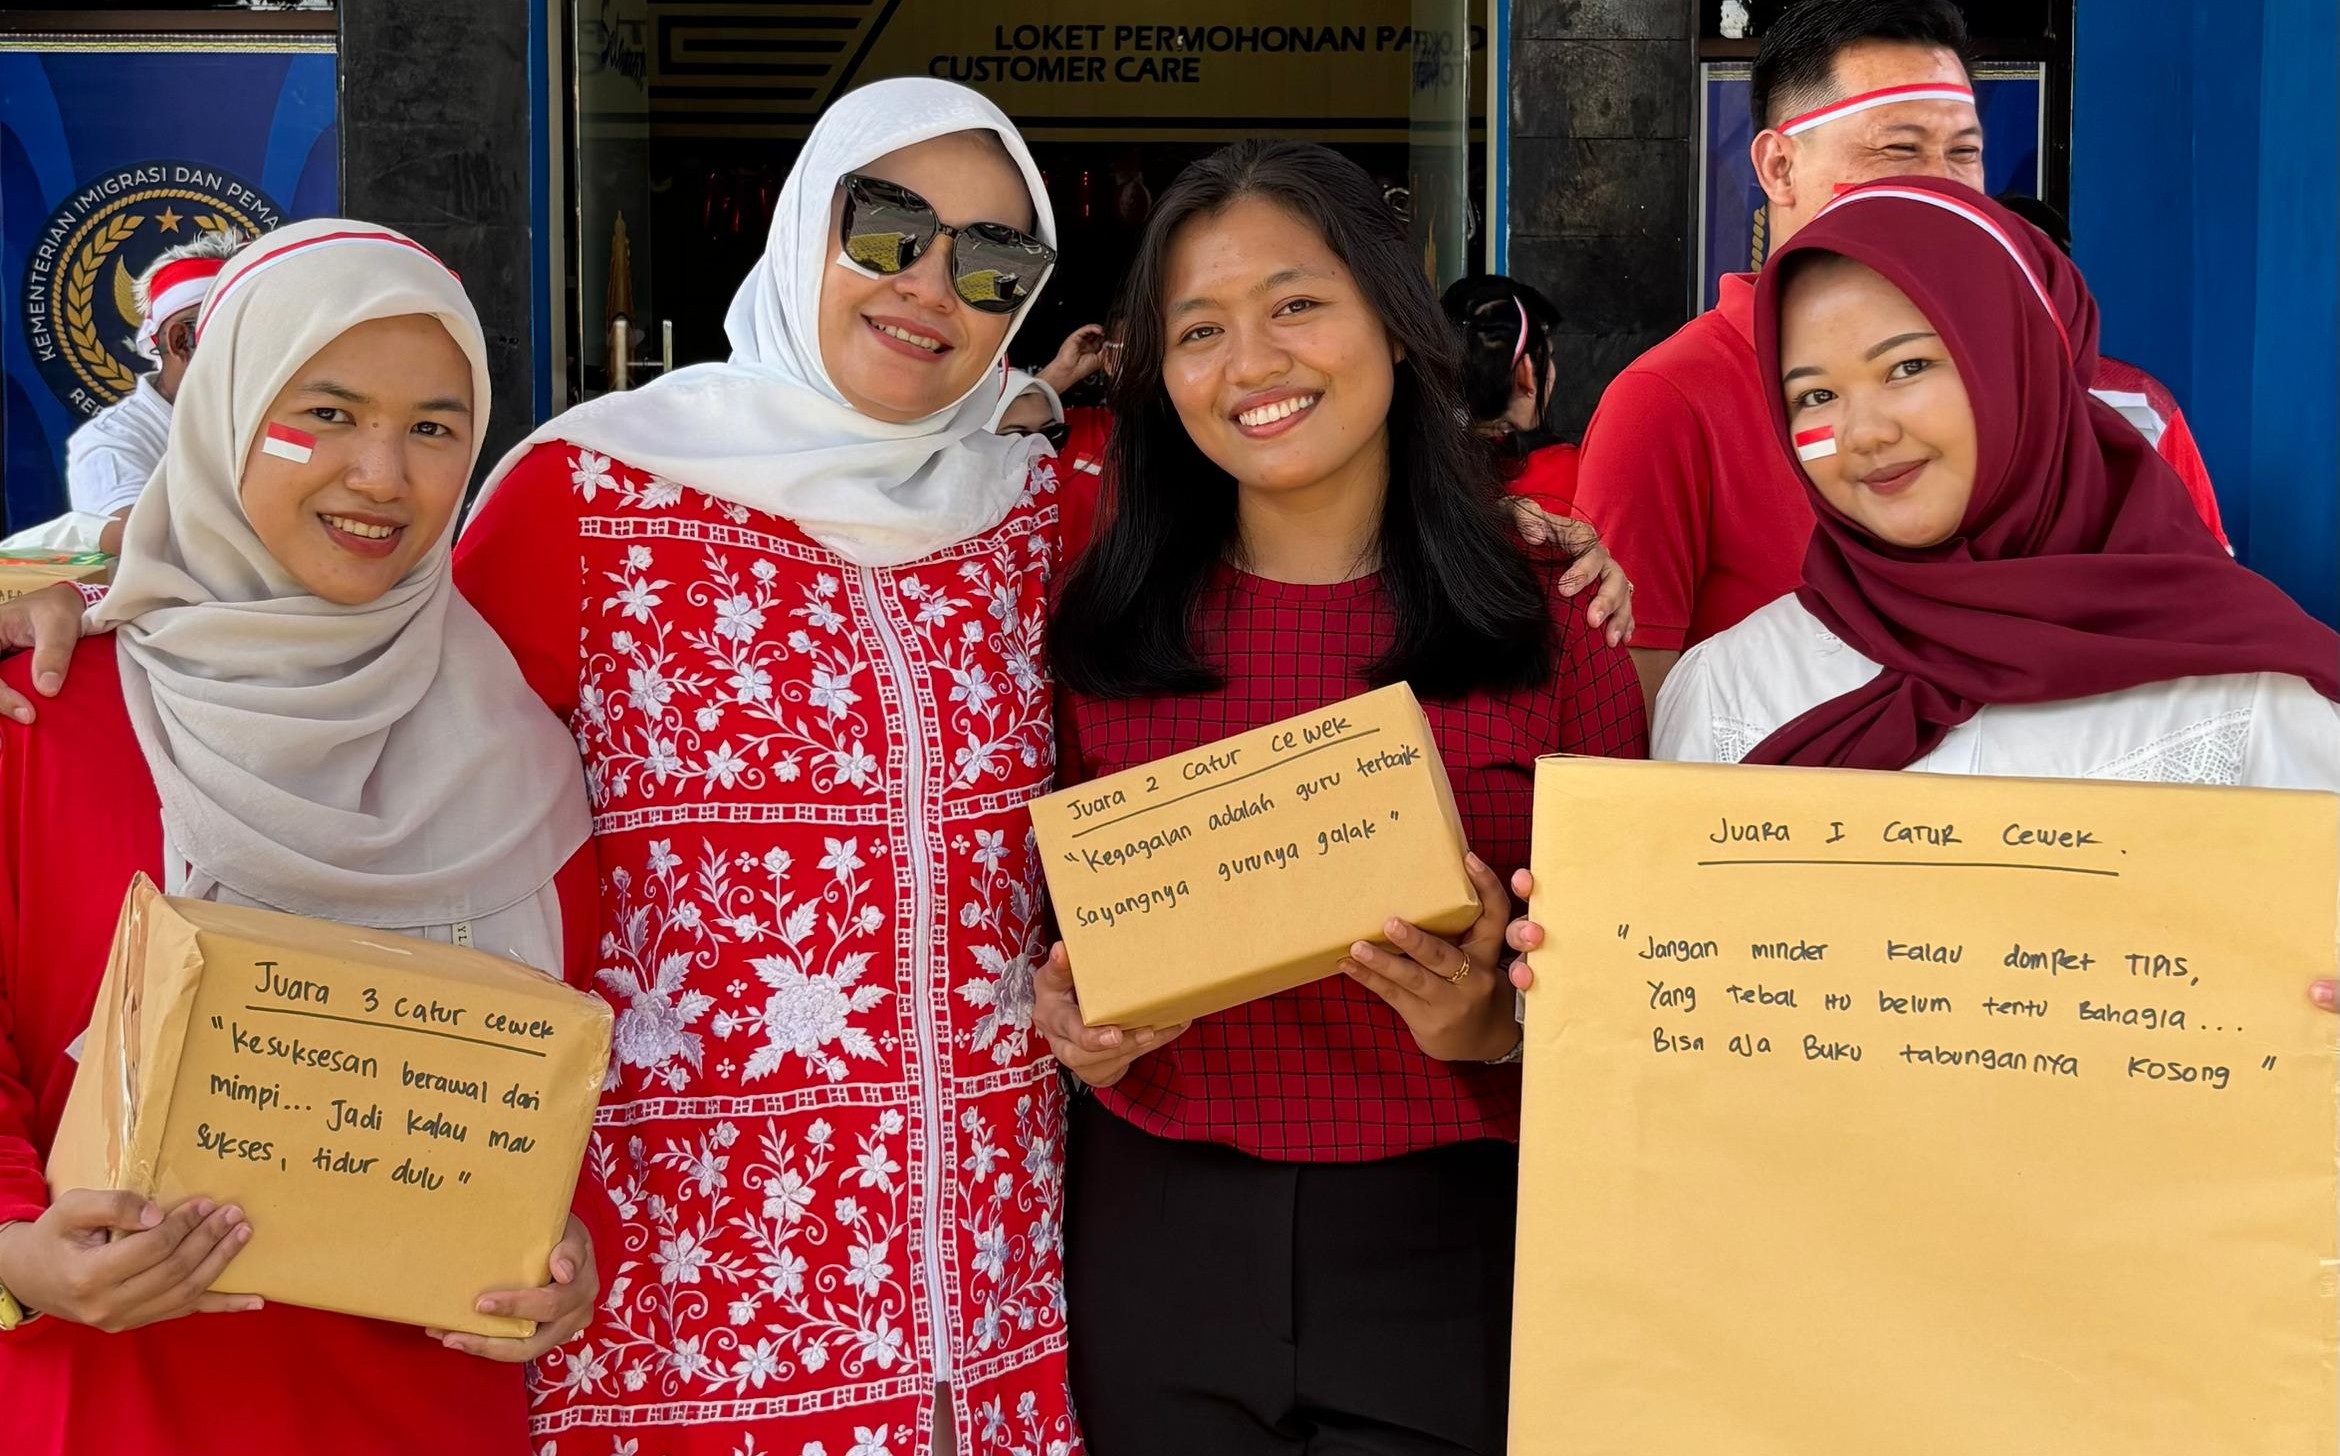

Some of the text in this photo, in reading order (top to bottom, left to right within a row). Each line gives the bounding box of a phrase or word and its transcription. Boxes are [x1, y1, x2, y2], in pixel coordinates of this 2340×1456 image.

[995, 24, 1106, 51] LOKET
[1114, 25, 1366, 53] PERMOHONAN
[928, 55, 1200, 83] CUSTOMER CARE
[26, 211, 78, 362] KEMENTERIAN
[74, 166, 167, 214] IMIGRASI
[175, 166, 223, 191] DAN
[1066, 790, 1127, 821] Juara
[1145, 775, 1160, 793] 2
[1271, 717, 1353, 753] cewek
[1208, 792, 1275, 831] adalah
[1295, 771, 1341, 802] guru
[1356, 743, 1421, 778] terbaik
[1217, 842, 1300, 882] gurunya
[1751, 939, 1829, 962] minder
[254, 961, 330, 1005] Juara
[361, 987, 380, 1013] 3
[484, 1012, 555, 1040] cewek
[1646, 980, 1697, 1014] Yang
[1878, 989, 1952, 1015] belum
[1981, 996, 2049, 1018] tentu
[1652, 1026, 1705, 1053] Bisa
[1898, 1043, 2079, 1078] tabungannya
[402, 1060, 488, 1104] berawal
[501, 1082, 540, 1111] dari
[326, 1099, 383, 1132] Jadi
[406, 1108, 468, 1143] kalau
[488, 1129, 536, 1154] mau
[311, 1146, 380, 1175] tidur
